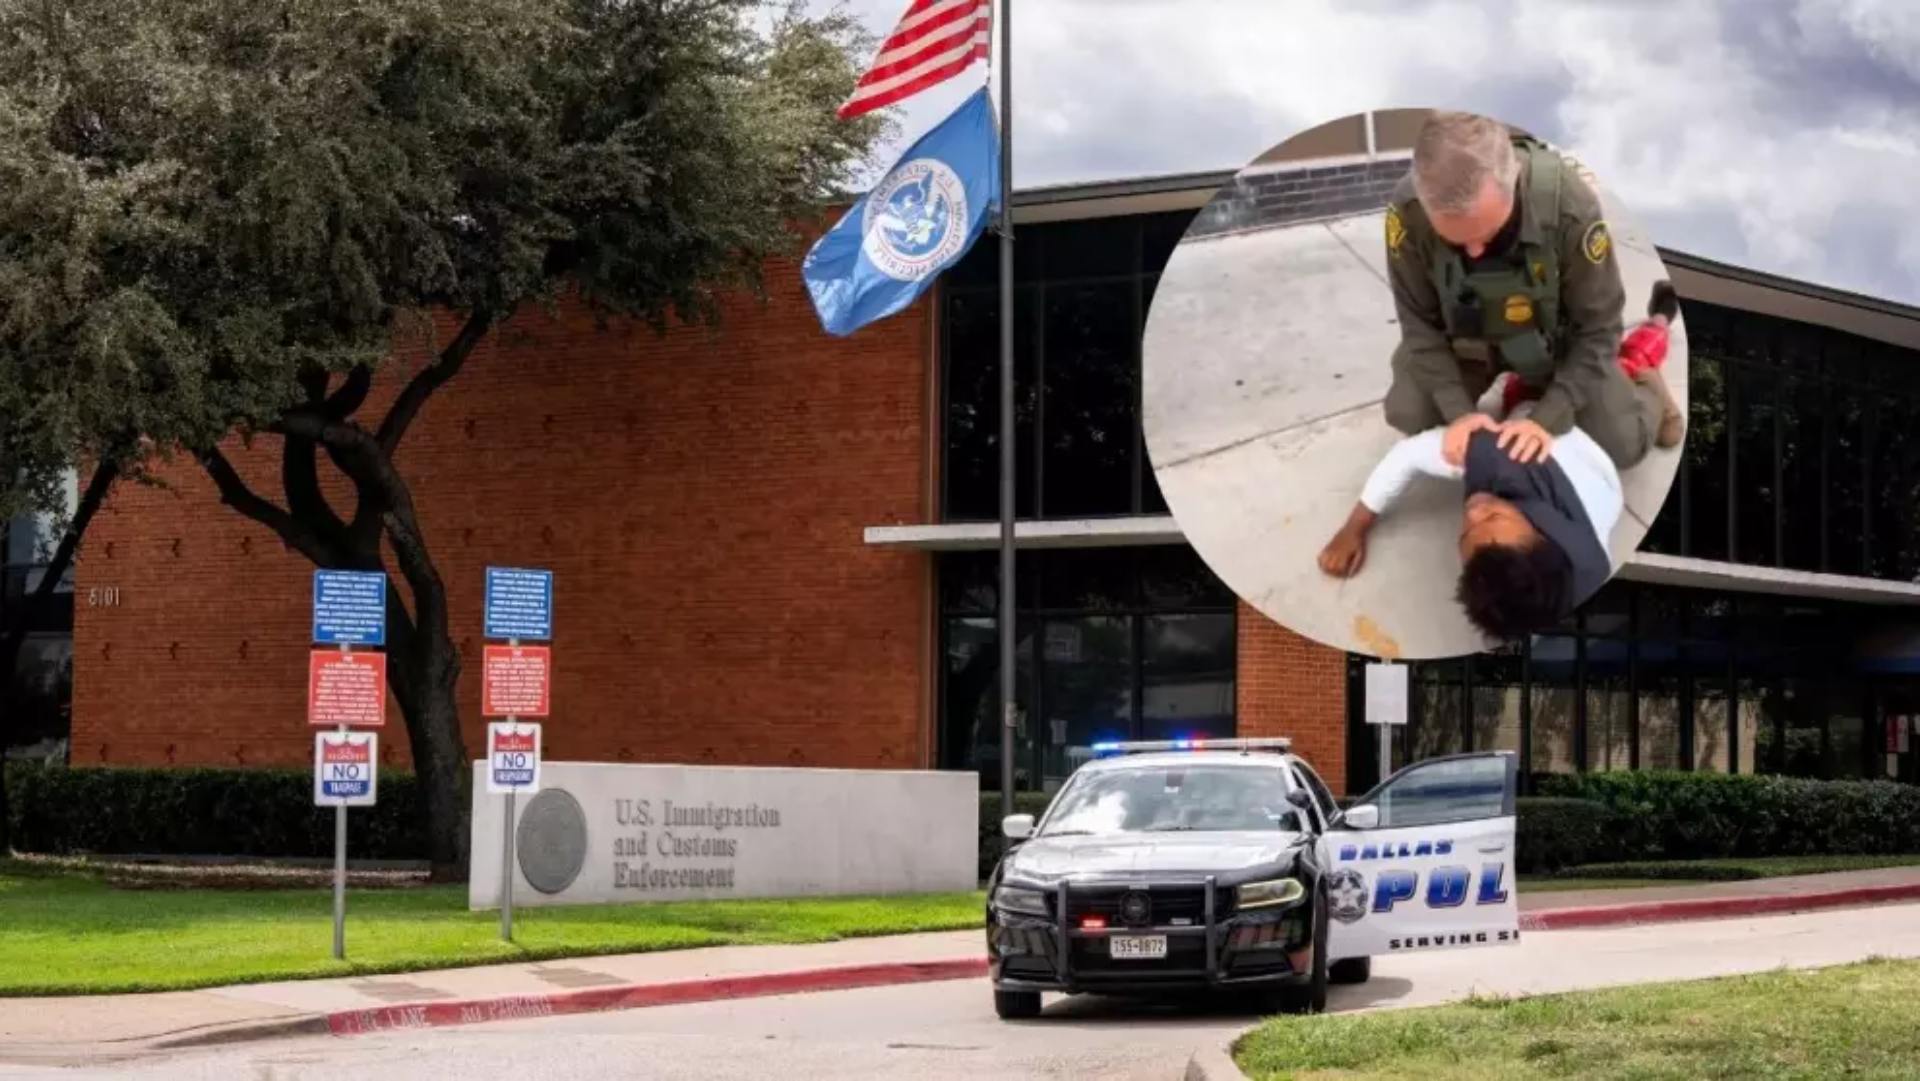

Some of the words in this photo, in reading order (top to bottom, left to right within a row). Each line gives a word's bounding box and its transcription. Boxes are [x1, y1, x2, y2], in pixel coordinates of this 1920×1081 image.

[503, 752, 526, 768] NO
[333, 764, 359, 779] NO
[615, 799, 654, 825] U.S.
[663, 800, 781, 830] Immigration
[614, 831, 648, 856] and
[656, 831, 737, 857] Customs
[1339, 840, 1453, 861] DALLAS
[614, 862, 735, 892] Enforcement
[1389, 932, 1487, 949] SERVING
